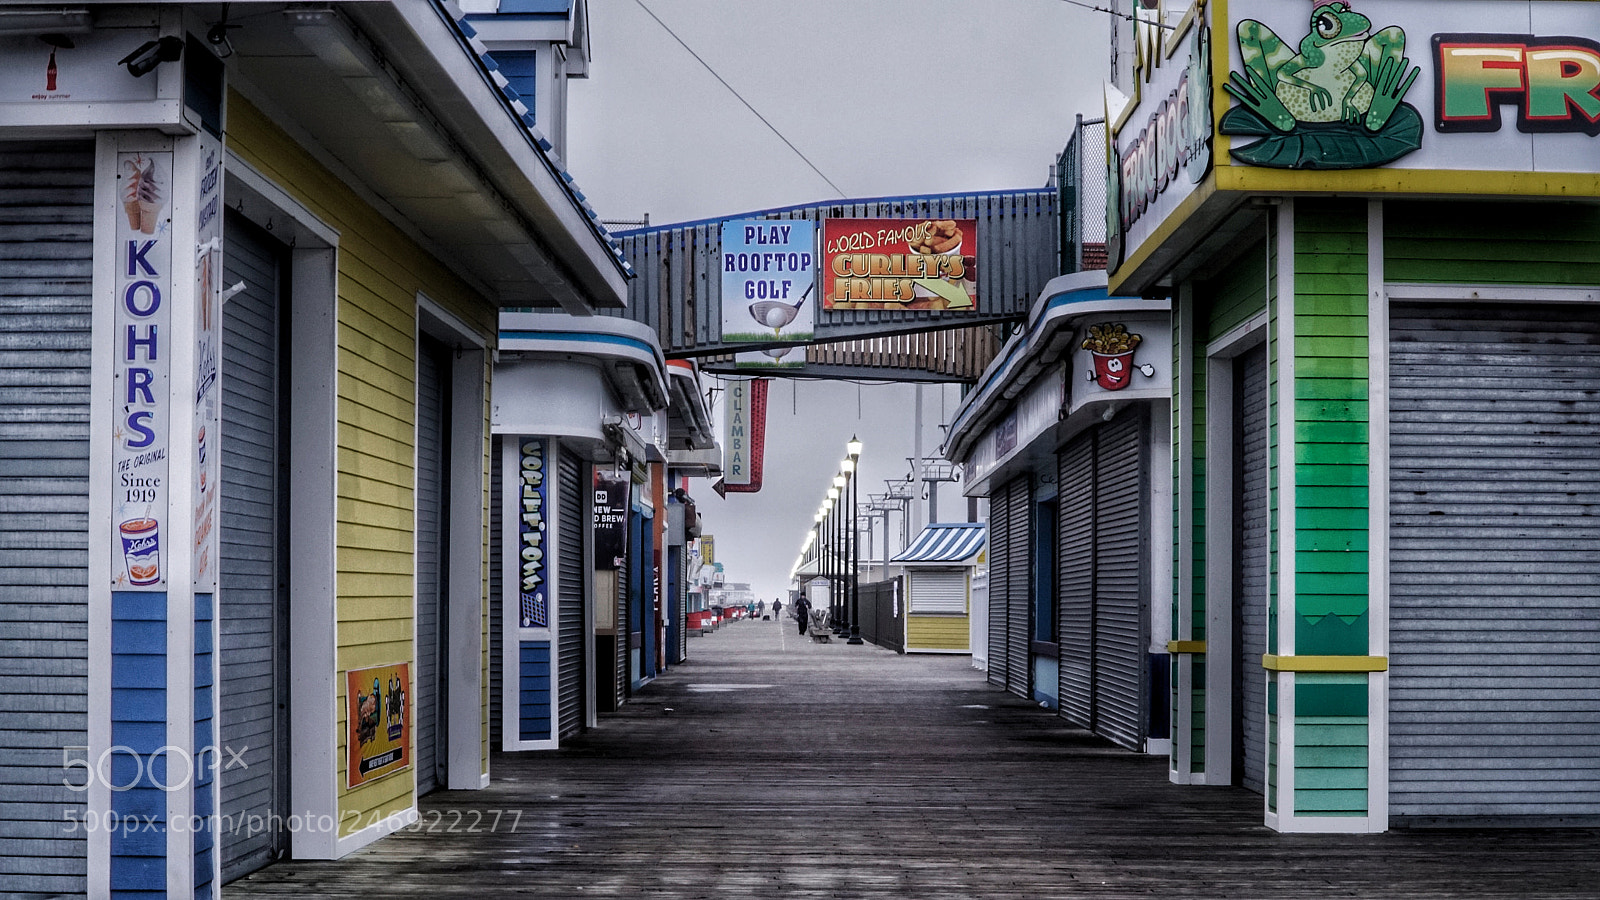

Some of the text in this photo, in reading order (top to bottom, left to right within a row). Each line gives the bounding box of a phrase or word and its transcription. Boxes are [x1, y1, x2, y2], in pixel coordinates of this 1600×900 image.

[1122, 79, 1188, 222] FROG BOG
[745, 225, 791, 245] PLAY
[827, 221, 932, 253] WORLD FAMOUS
[724, 253, 811, 272] ROOFTOP
[832, 253, 965, 279] CURLEY'S
[744, 280, 792, 299] GOLF
[834, 277, 916, 302] FRIES
[117, 448, 166, 473] THE ORIGINAL
[121, 473, 161, 488] Since
[125, 489, 156, 503] 1919
[601, 514, 624, 523] BREW
